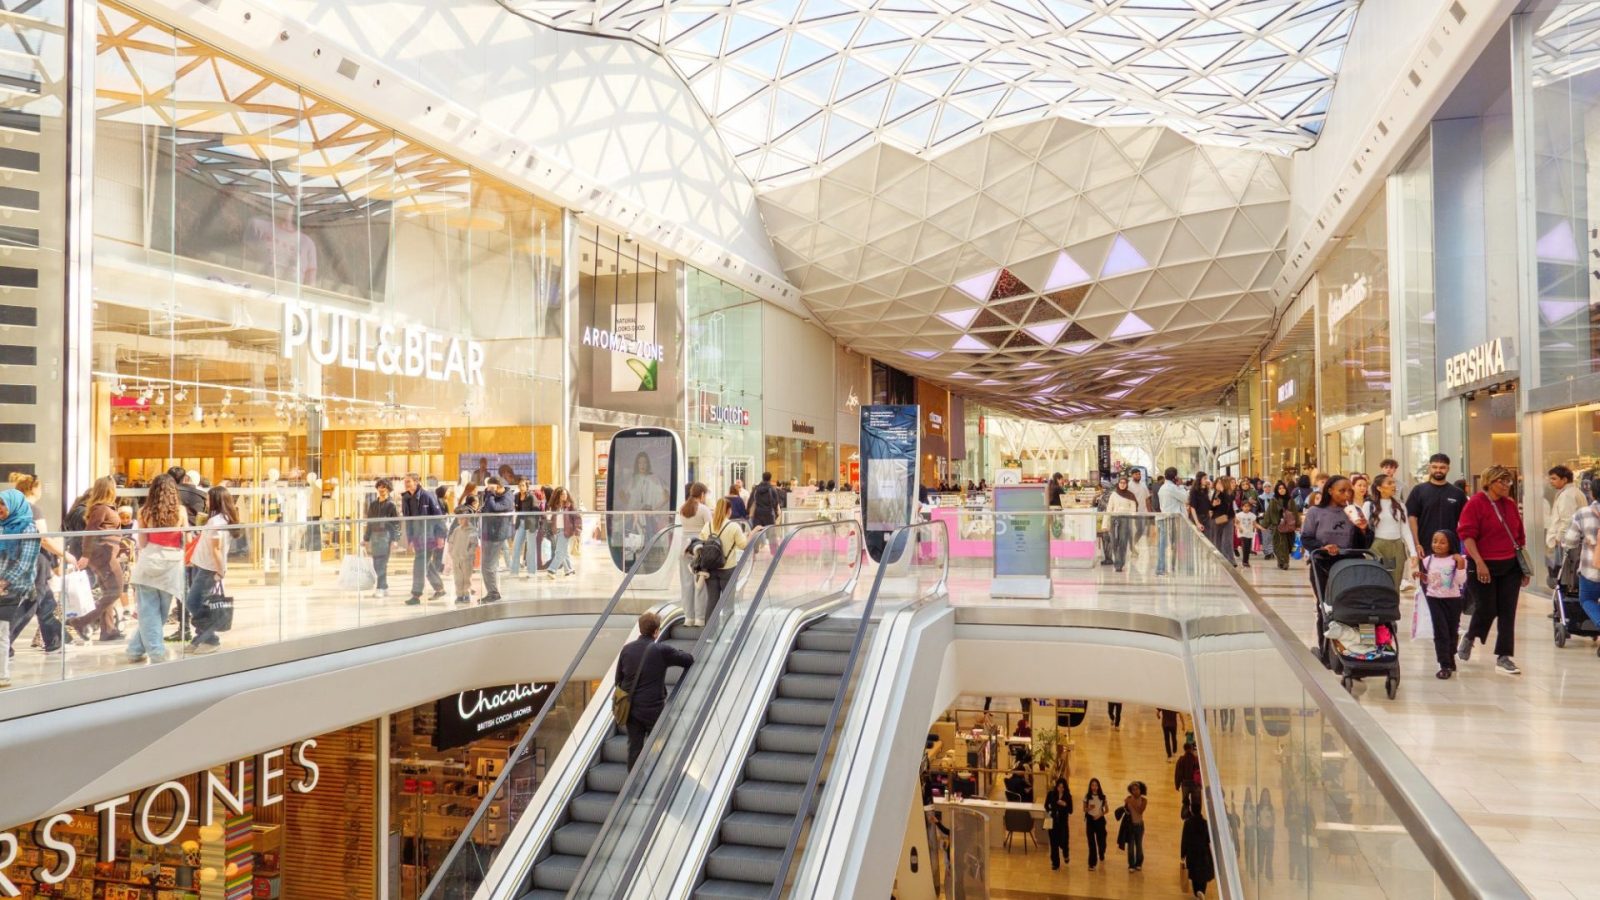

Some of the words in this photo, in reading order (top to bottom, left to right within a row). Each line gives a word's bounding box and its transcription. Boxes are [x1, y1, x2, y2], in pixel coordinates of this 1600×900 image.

[282, 302, 485, 386] PULL&BEAR
[1446, 337, 1506, 388] BERSHKA
[710, 405, 743, 424] swatch
[477, 718, 495, 732] BRITISH
[495, 713, 513, 725] COCOA
[513, 706, 532, 719] GROWER
